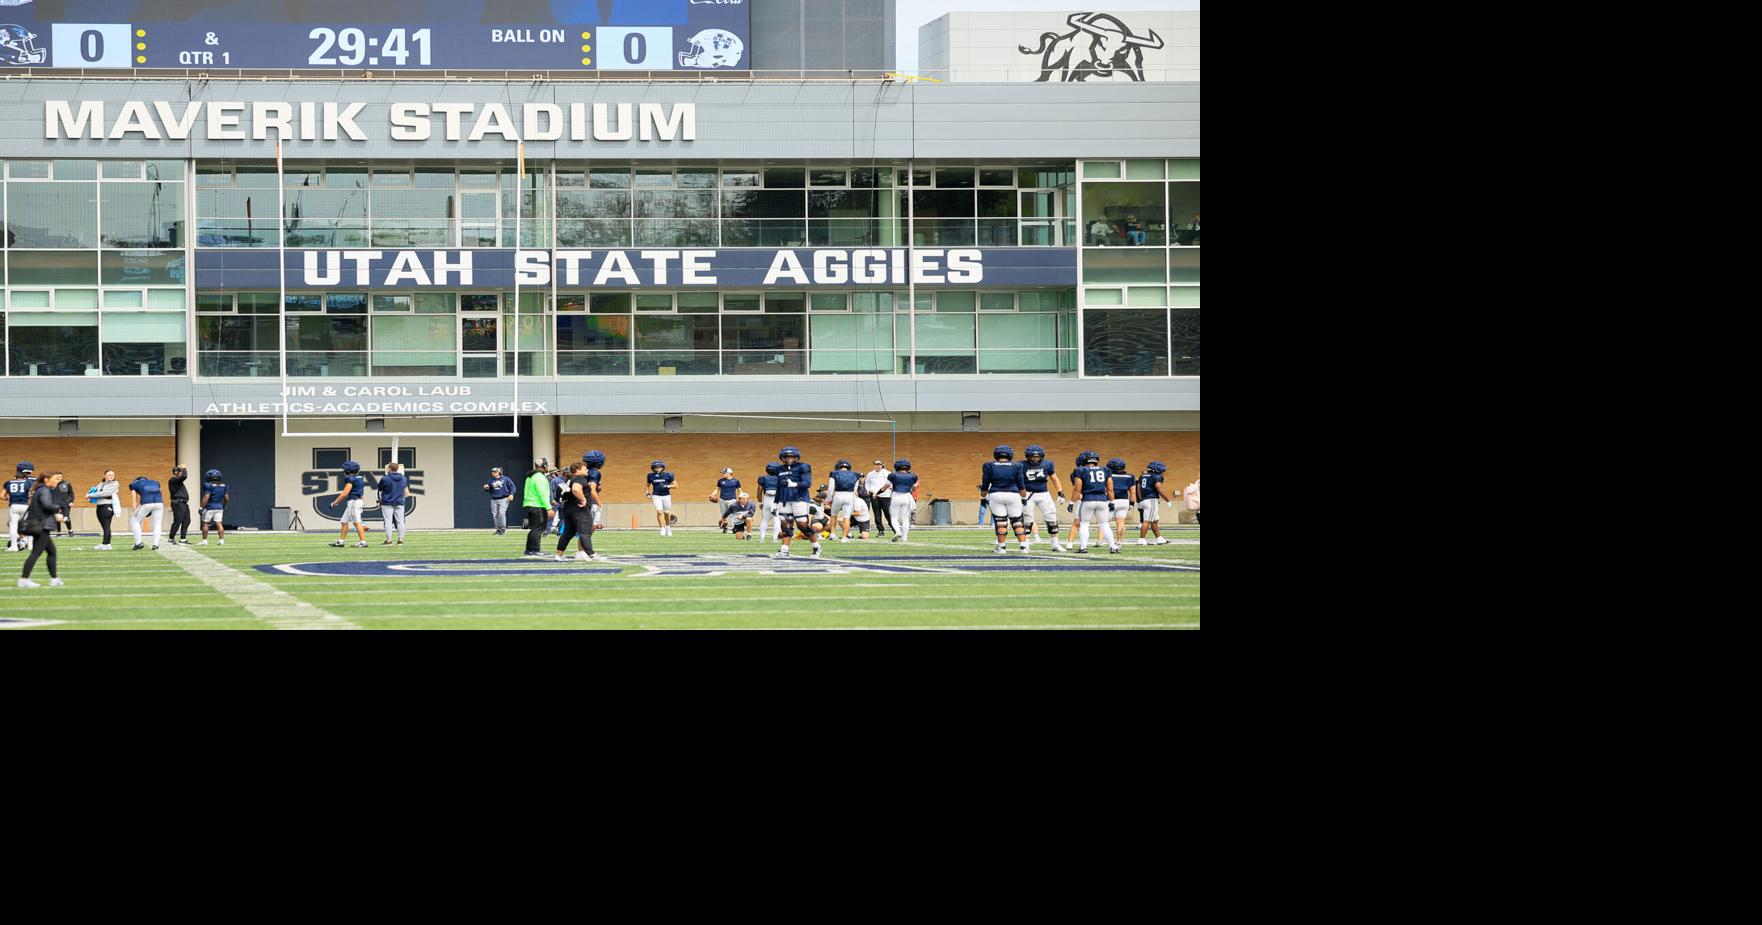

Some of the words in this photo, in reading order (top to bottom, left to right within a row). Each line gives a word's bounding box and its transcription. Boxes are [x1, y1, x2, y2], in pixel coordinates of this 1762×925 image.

[205, 31, 219, 46] &
[491, 29, 535, 43] BALL
[539, 29, 565, 43] ON
[80, 29, 105, 63] 0
[308, 27, 432, 66] 29:41
[623, 32, 647, 65] 0
[179, 51, 214, 66] QTR
[222, 51, 231, 65] 1
[45, 100, 369, 140] MAVERIK
[390, 102, 696, 141] STADIUM
[303, 250, 473, 286] UTAH
[515, 250, 717, 285] STATE
[763, 249, 983, 285] AGGIES
[280, 386, 316, 397] JIM
[322, 385, 337, 397] &
[343, 385, 413, 397] CAROL
[418, 385, 472, 396] LAUB
[204, 401, 445, 414] ATHLETCS-ACADEMICS
[449, 400, 548, 413] COMPLEX
[1089, 470, 1105, 482] 18
[1141, 478, 1147, 488] 8
[10, 483, 25, 492] 81
